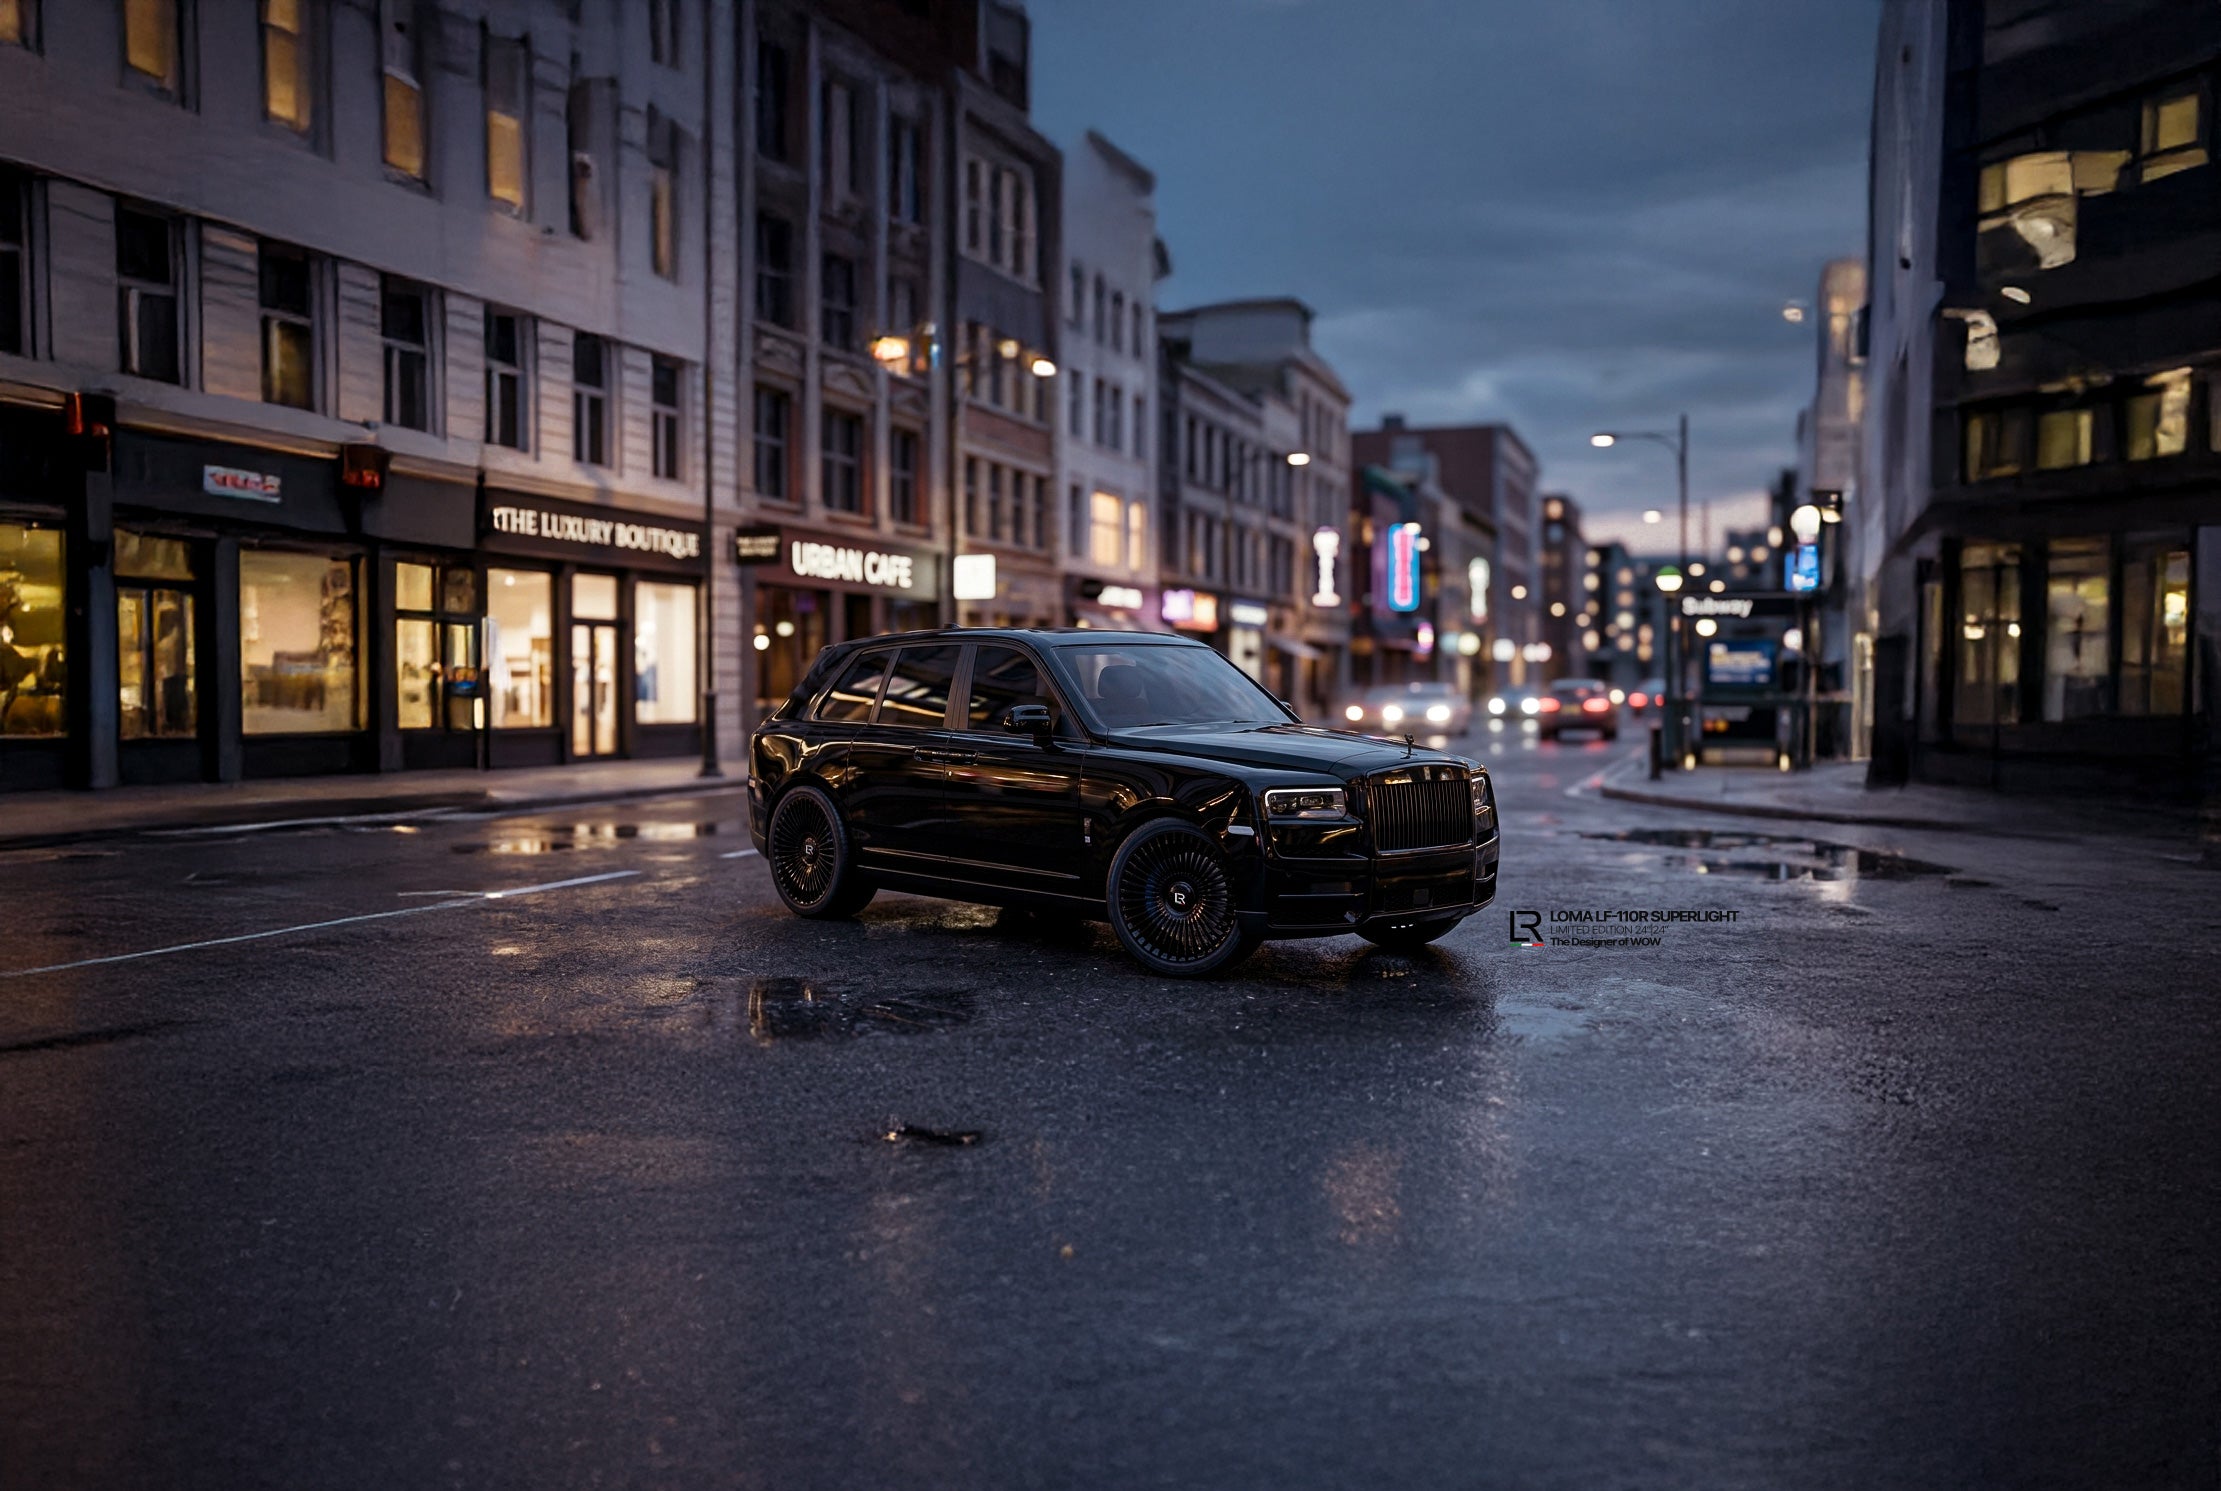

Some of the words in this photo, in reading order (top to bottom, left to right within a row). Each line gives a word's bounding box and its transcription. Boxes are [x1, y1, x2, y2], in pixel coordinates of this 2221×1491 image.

[541, 512, 614, 545] LUXURY
[614, 522, 700, 559] BOUTIQUE
[792, 541, 863, 582] URBAN
[864, 551, 913, 588] CAFE
[1682, 596, 1753, 618] Subway
